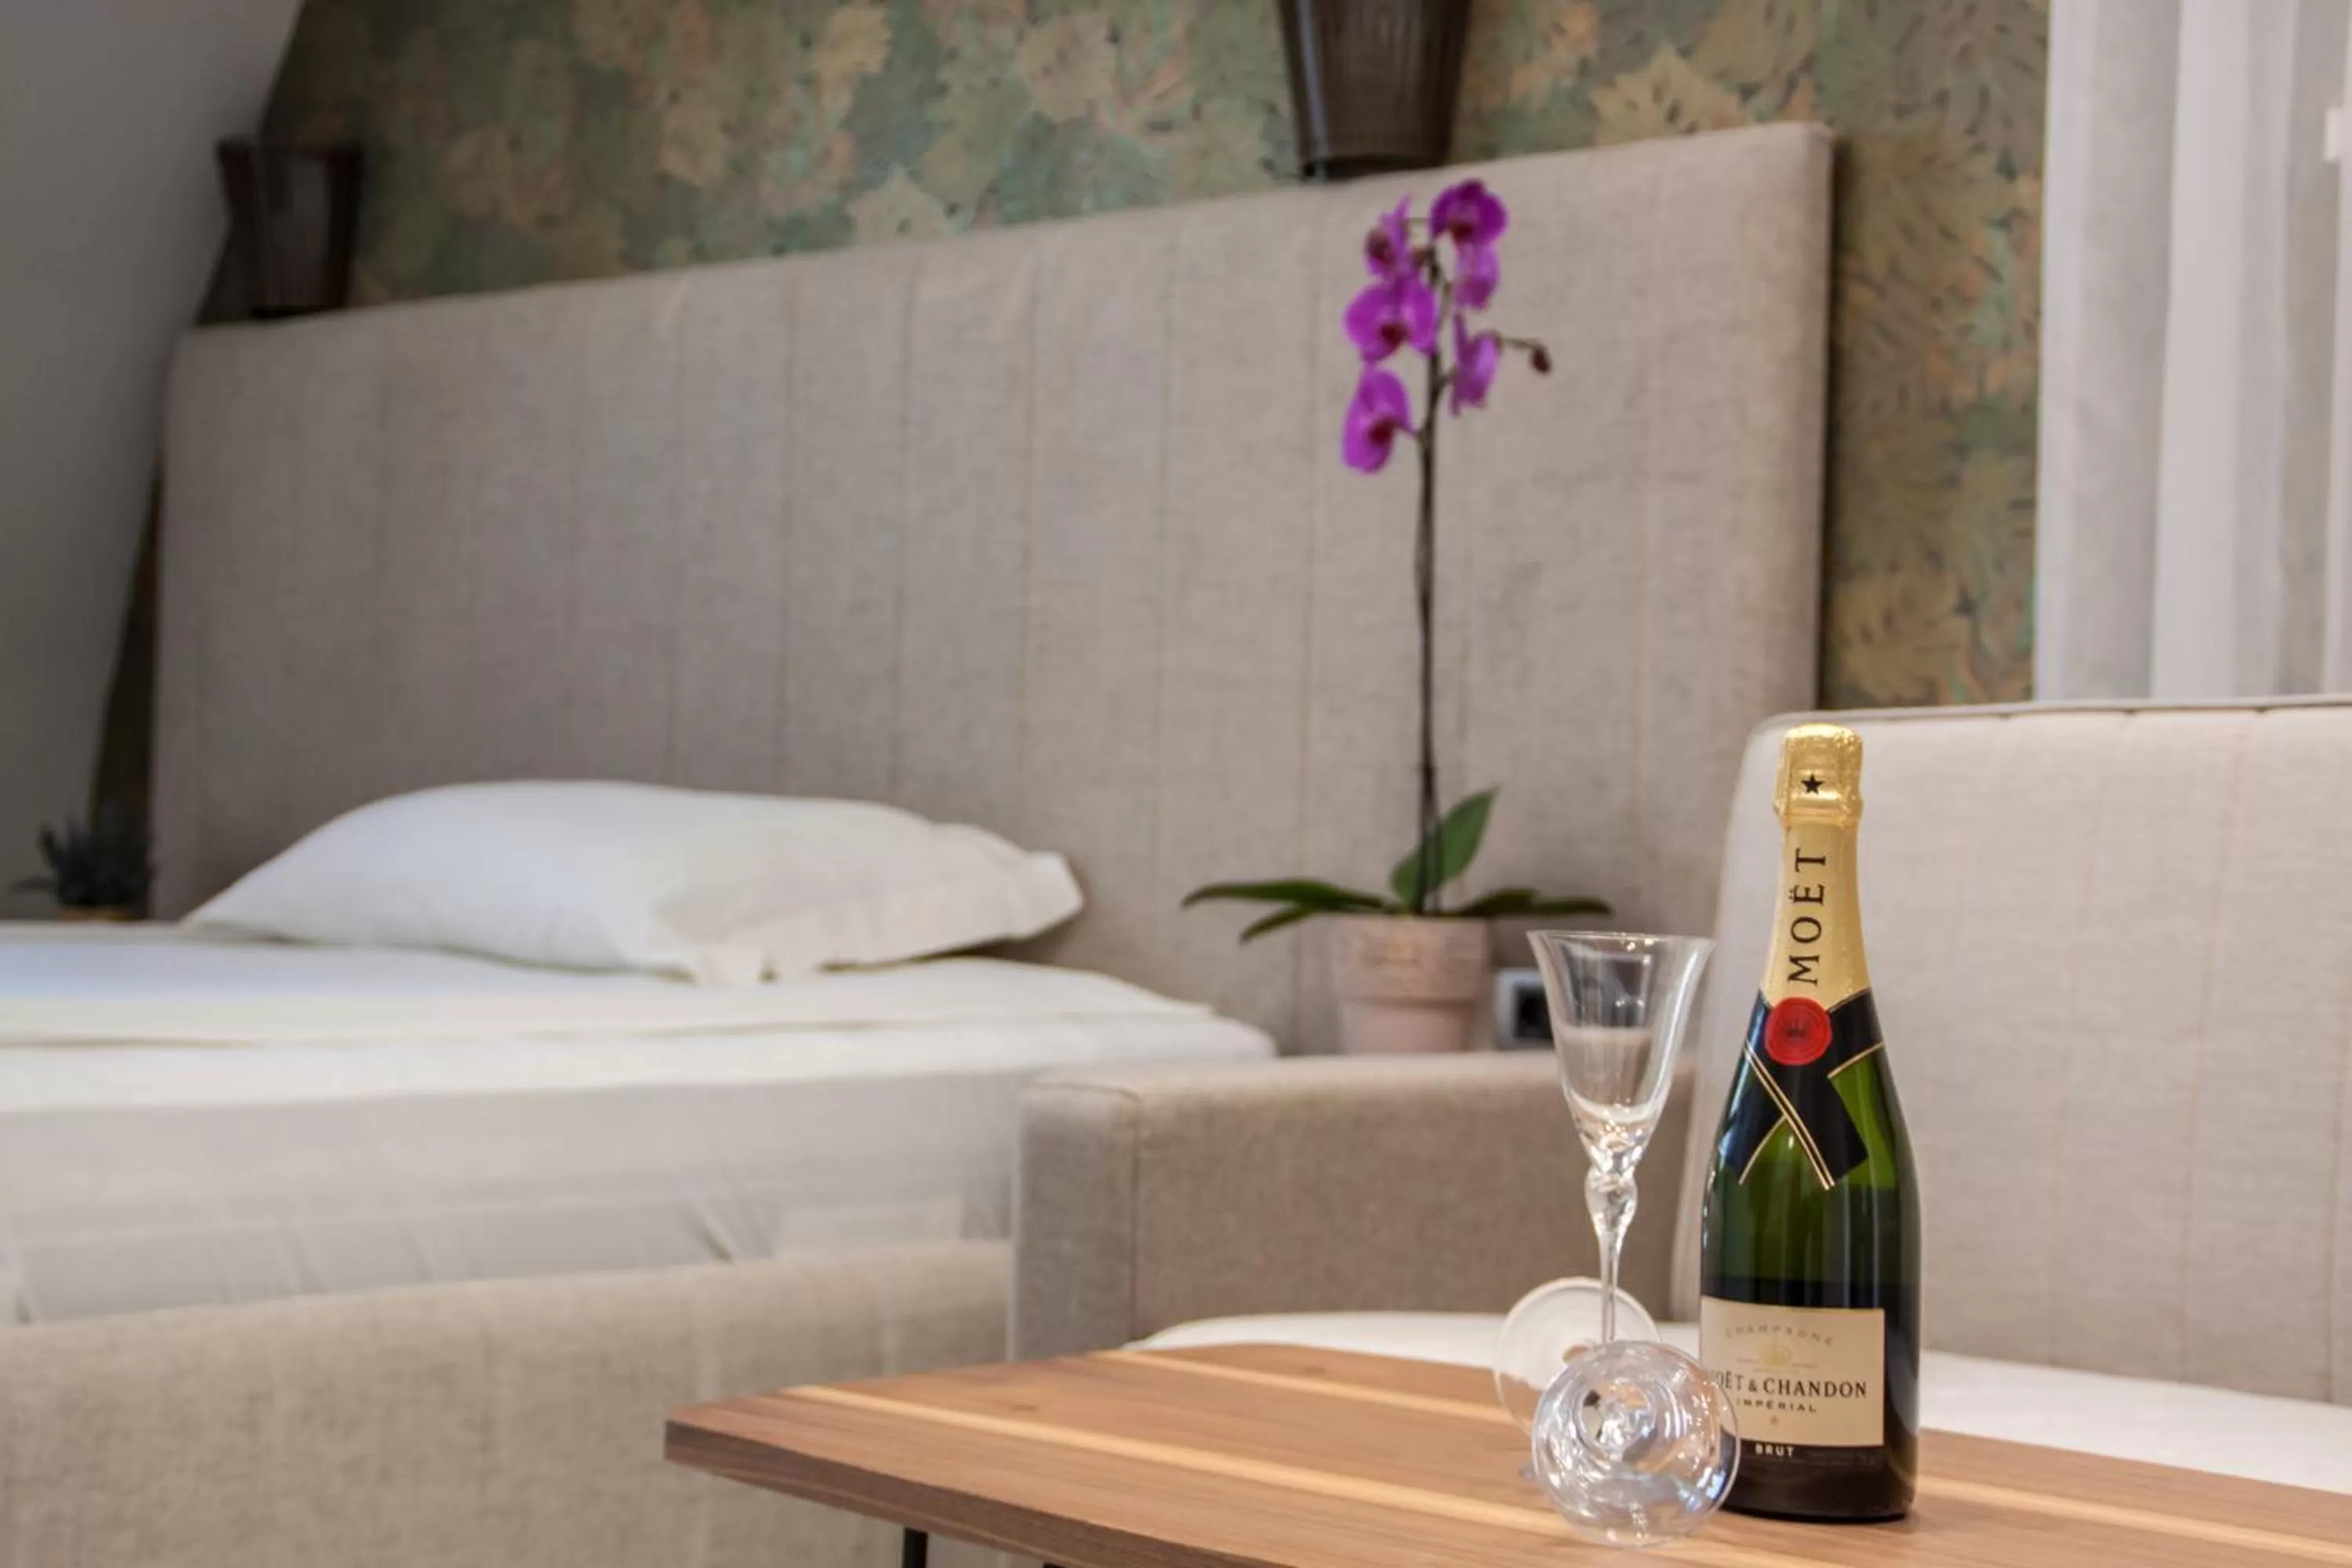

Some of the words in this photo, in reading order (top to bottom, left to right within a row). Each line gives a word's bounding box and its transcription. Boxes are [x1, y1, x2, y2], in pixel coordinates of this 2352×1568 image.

[1788, 848, 1827, 985] MOËT
[1726, 1323, 1833, 1347] CHAMPAGNE
[1748, 1377, 1759, 1393] &
[1763, 1377, 1867, 1399] CHANDON
[1755, 1443, 1795, 1457] BRUT
